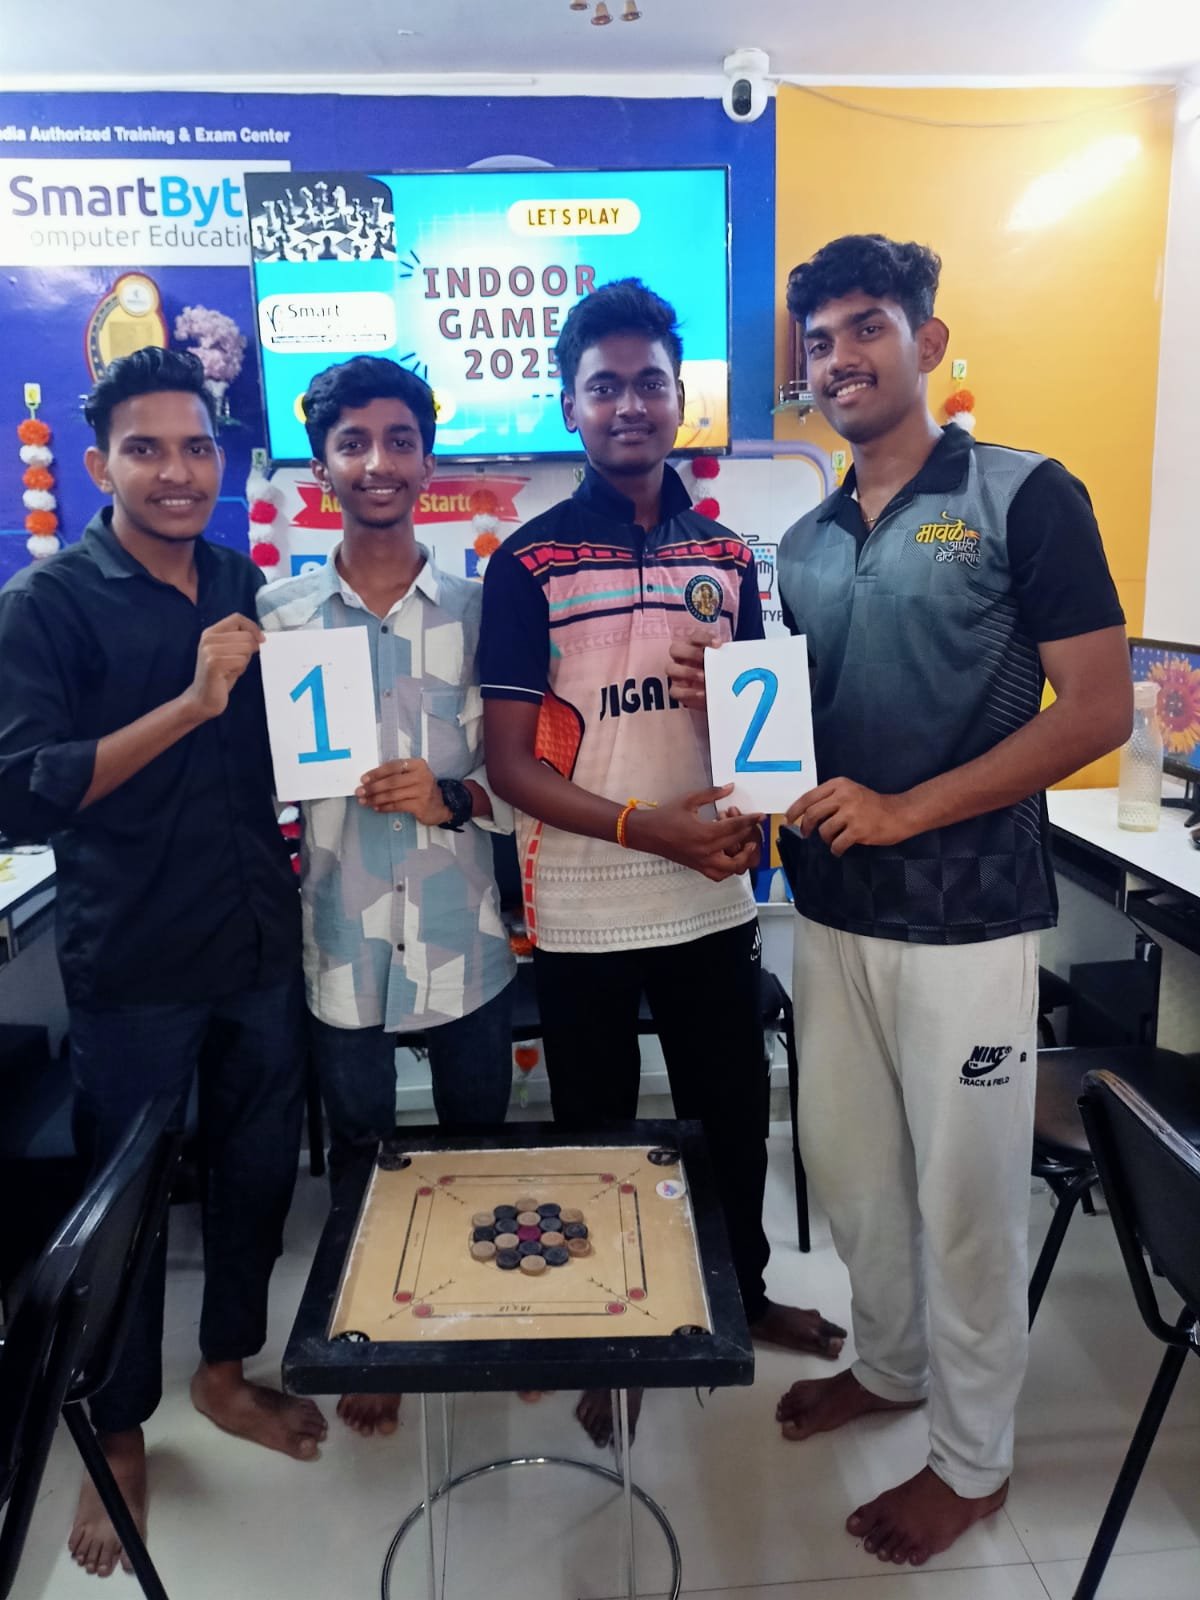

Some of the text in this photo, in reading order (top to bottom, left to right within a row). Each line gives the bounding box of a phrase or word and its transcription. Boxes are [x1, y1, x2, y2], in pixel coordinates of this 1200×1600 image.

[0, 125, 291, 144] dia Authorized Training & Exam Center
[577, 207, 619, 224] PLAY
[149, 223, 249, 247] Educati
[423, 265, 597, 298] INDOOR
[438, 306, 573, 339] GAME
[420, 493, 473, 513] Start
[289, 664, 352, 764] 1
[732, 667, 802, 773] 2
[970, 1045, 1006, 1064] NIKE
[959, 1076, 985, 1087] TRACK
[992, 1076, 1010, 1086] FIELD
